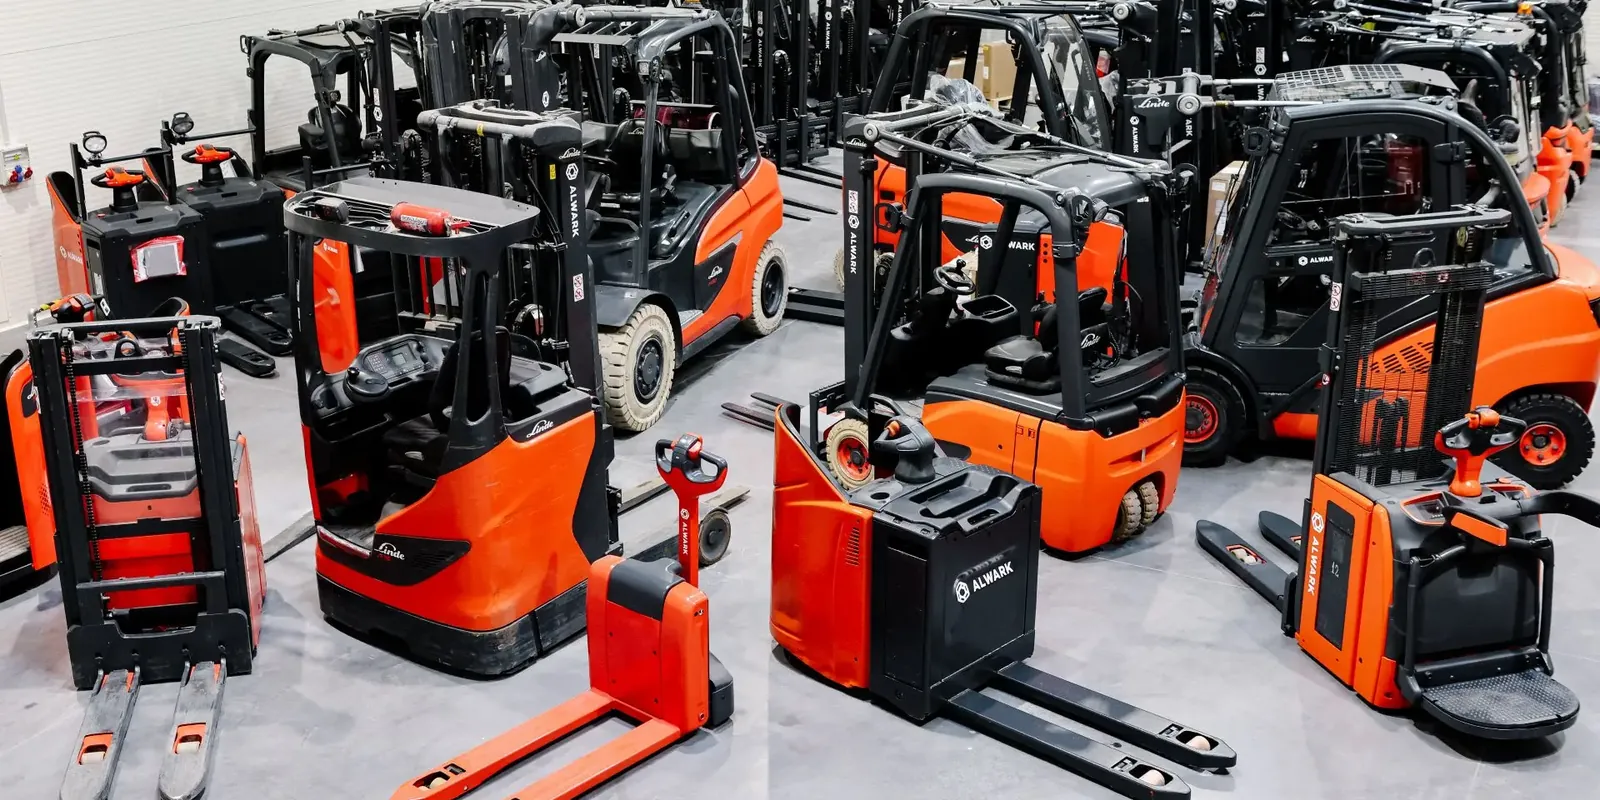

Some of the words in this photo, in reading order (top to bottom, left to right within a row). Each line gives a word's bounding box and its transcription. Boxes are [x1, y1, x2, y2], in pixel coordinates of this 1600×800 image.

[1134, 96, 1170, 109] Linde
[845, 138, 868, 148] Linde
[559, 147, 581, 160] Linde
[569, 185, 580, 238] ALWARK
[1008, 240, 1036, 251] WARK
[1309, 255, 1334, 264] ALWAR
[526, 419, 554, 438] Linde
[373, 542, 405, 560] Linde
[1307, 535, 1320, 597] ALWARK
[972, 561, 1015, 593] ALWARK
